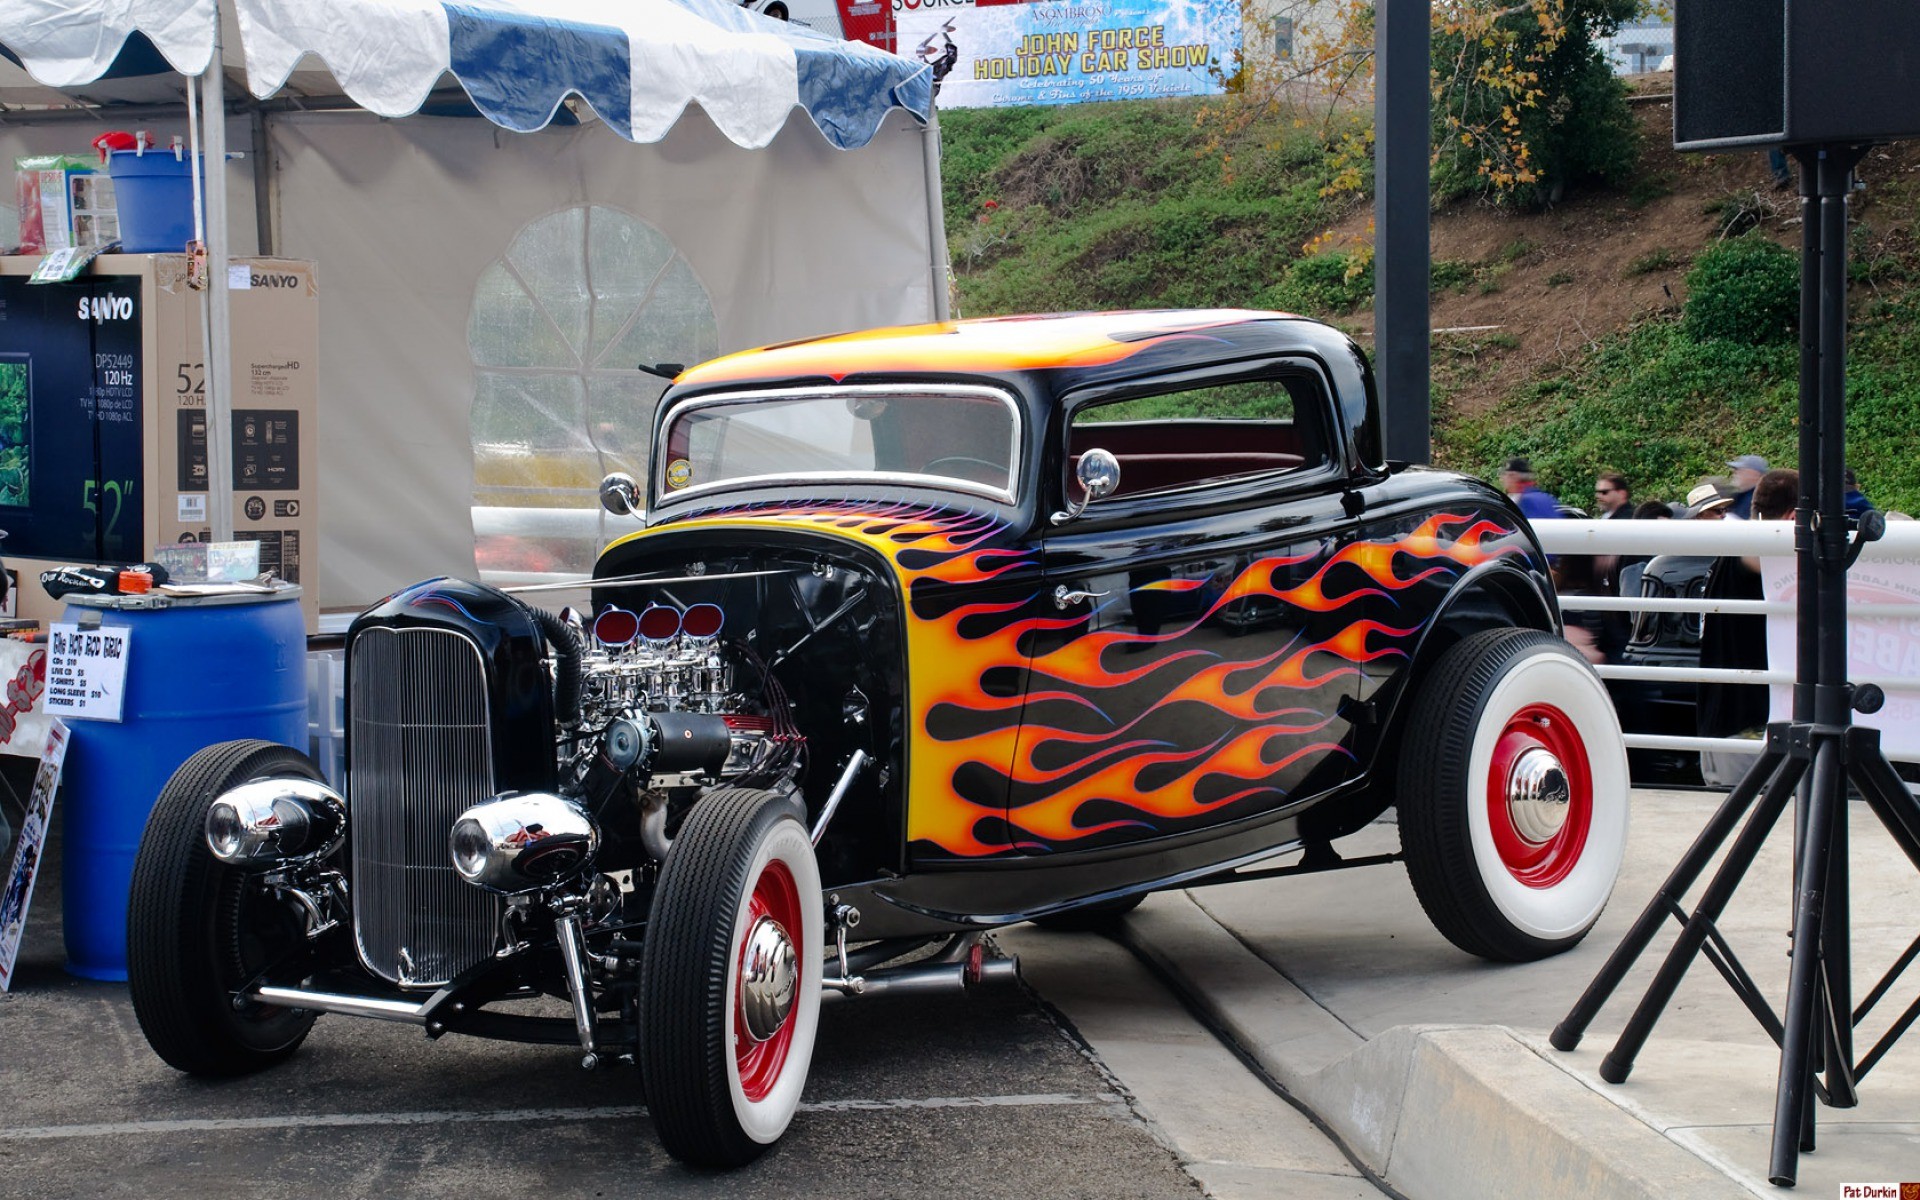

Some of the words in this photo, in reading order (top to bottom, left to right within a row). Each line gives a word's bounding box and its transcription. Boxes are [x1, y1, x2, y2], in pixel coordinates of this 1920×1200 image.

[892, 0, 974, 10] SOU
[1032, 6, 1112, 20] ASOMBROSO
[1015, 31, 1078, 56] JOHN
[1087, 25, 1164, 50] FORCE
[973, 53, 1072, 80] HOLIDAY
[1081, 49, 1129, 74] CAR
[1137, 44, 1209, 69] SHOW
[1020, 78, 1084, 89] Celebrating
[1089, 74, 1105, 85] 50
[1108, 73, 1143, 83] Years
[1147, 72, 1163, 83] of
[1037, 90, 1046, 100] &
[1050, 89, 1076, 99] Fins
[1080, 88, 1092, 99] of
[1094, 88, 1114, 97] the
[1118, 85, 1145, 96] 1959
[1148, 83, 1191, 94] Vehicle
[250, 273, 298, 289] SANYO
[78, 292, 133, 325] SANYO
[95, 353, 133, 368] DP52449
[104, 371, 120, 385] 120
[120, 370, 133, 385] Hz
[89, 387, 105, 397] 10p
[105, 387, 121, 397] HDTV
[122, 388, 133, 397] LCD
[122, 400, 133, 409] LCD
[178, 396, 194, 406] 120
[196, 396, 207, 406] H
[122, 412, 133, 421] ACL
[83, 480, 133, 542] 52"
[53, 632, 66, 655] The
[68, 633, 83, 656] HOT
[85, 634, 101, 657] ROD
[103, 635, 122, 659] TRIO
[52, 657, 63, 665] CDs
[67, 658, 77, 666] $10
[51, 667, 63, 675] LIVE
[77, 669, 84, 677] $5
[50, 677, 75, 686] T-SHIRTS
[79, 679, 87, 687] $5
[49, 687, 66, 695] LONG
[67, 688, 86, 697] SLEEVE
[91, 690, 102, 698] $10
[48, 697, 74, 706] STICKERS
[79, 699, 86, 707] $1
